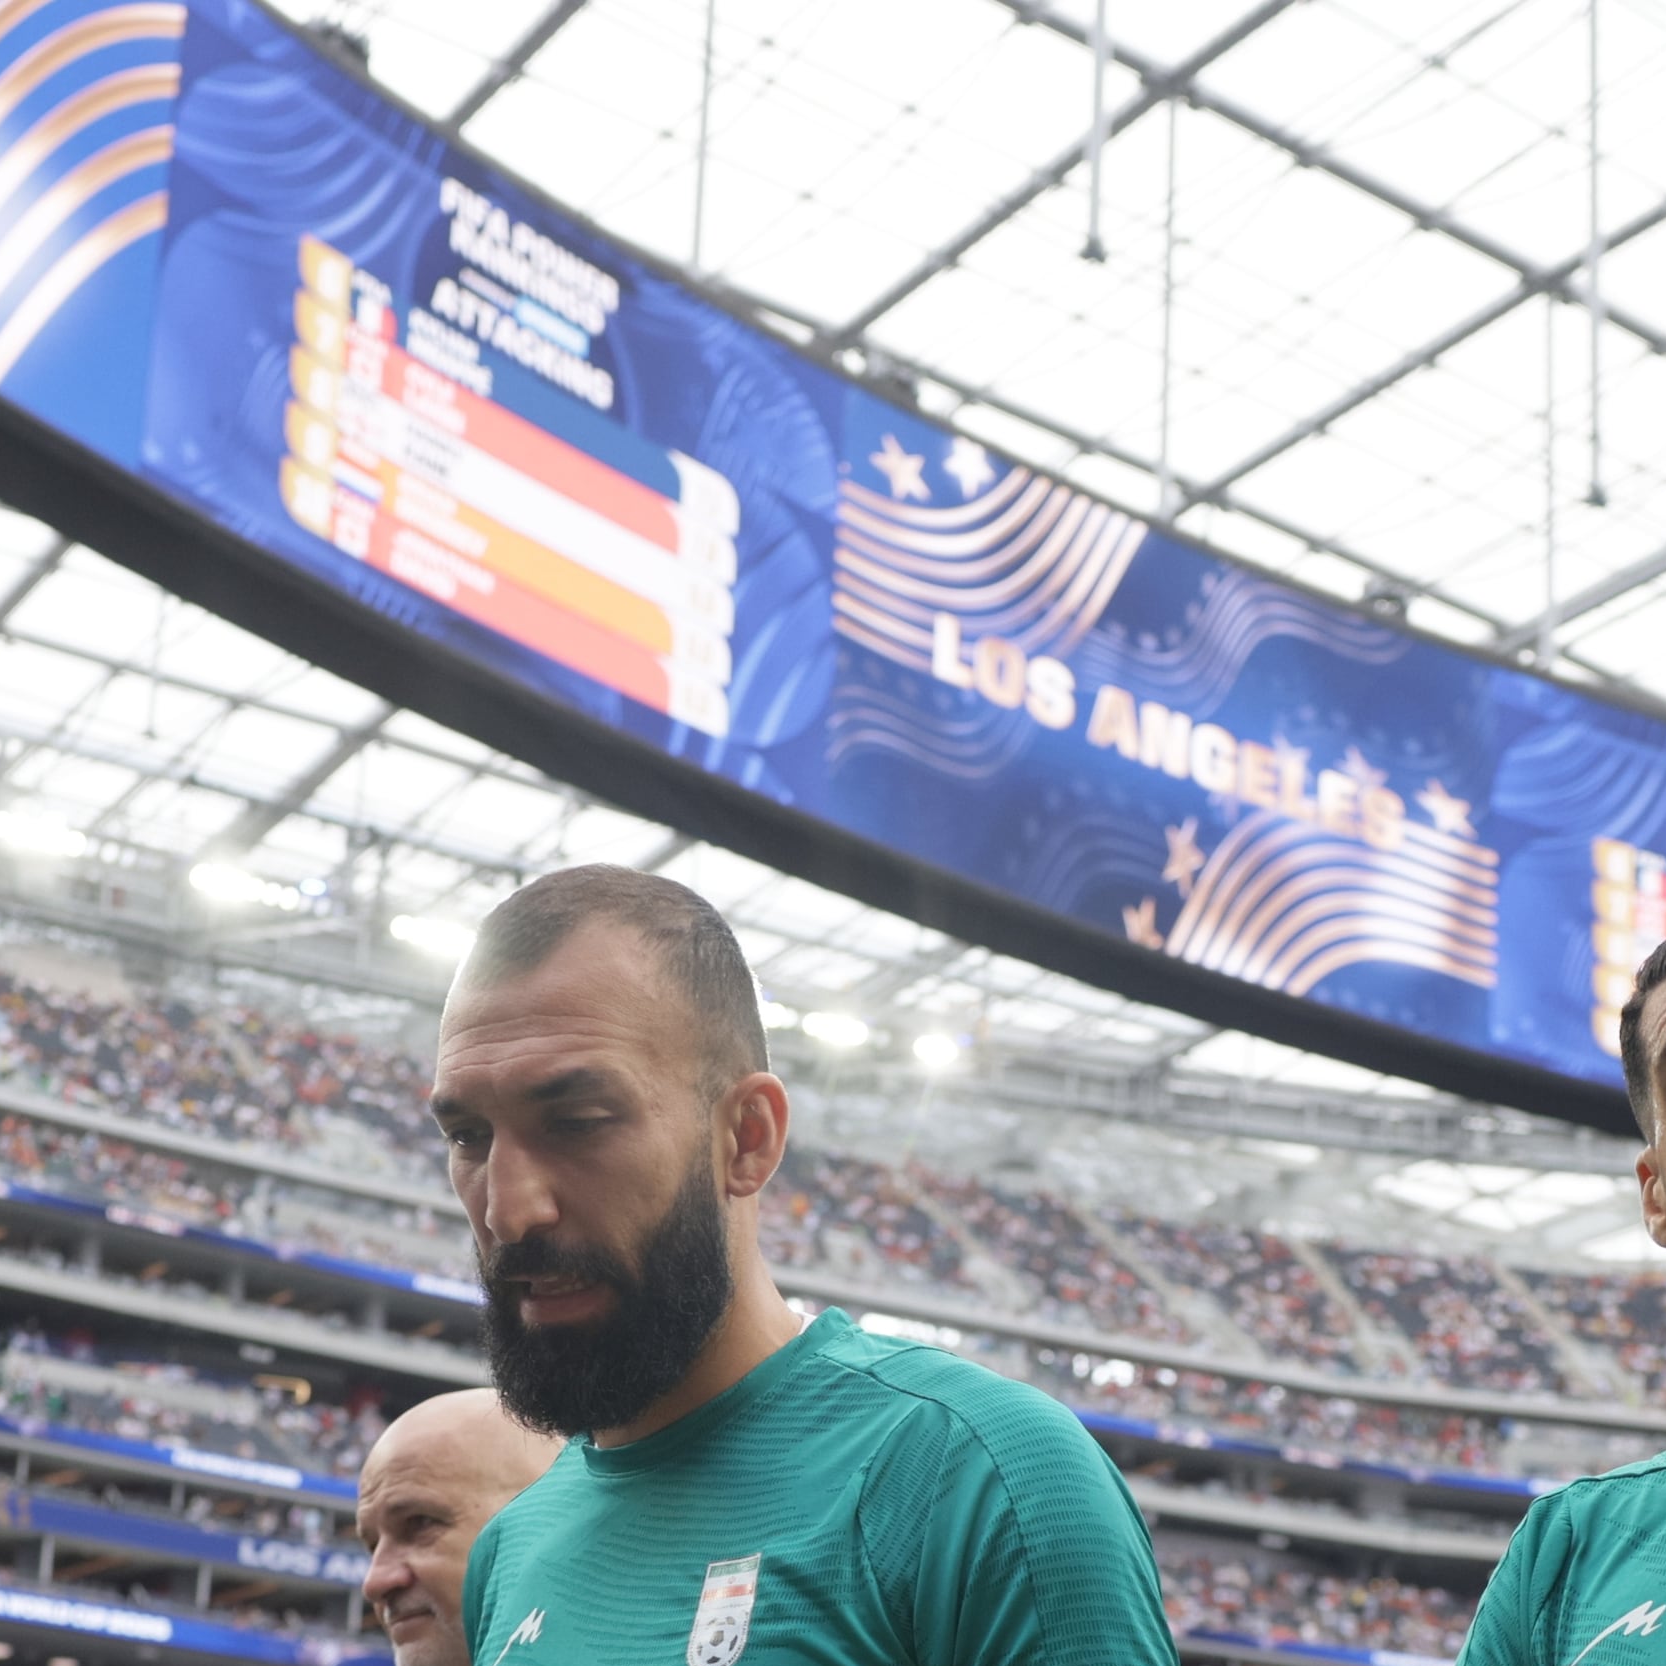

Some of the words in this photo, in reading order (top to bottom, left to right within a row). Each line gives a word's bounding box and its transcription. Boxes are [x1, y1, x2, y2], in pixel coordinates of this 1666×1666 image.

[932, 611, 1077, 730] LOS
[1085, 684, 1407, 850] ANGELES
[238, 1536, 320, 1576] LOS
